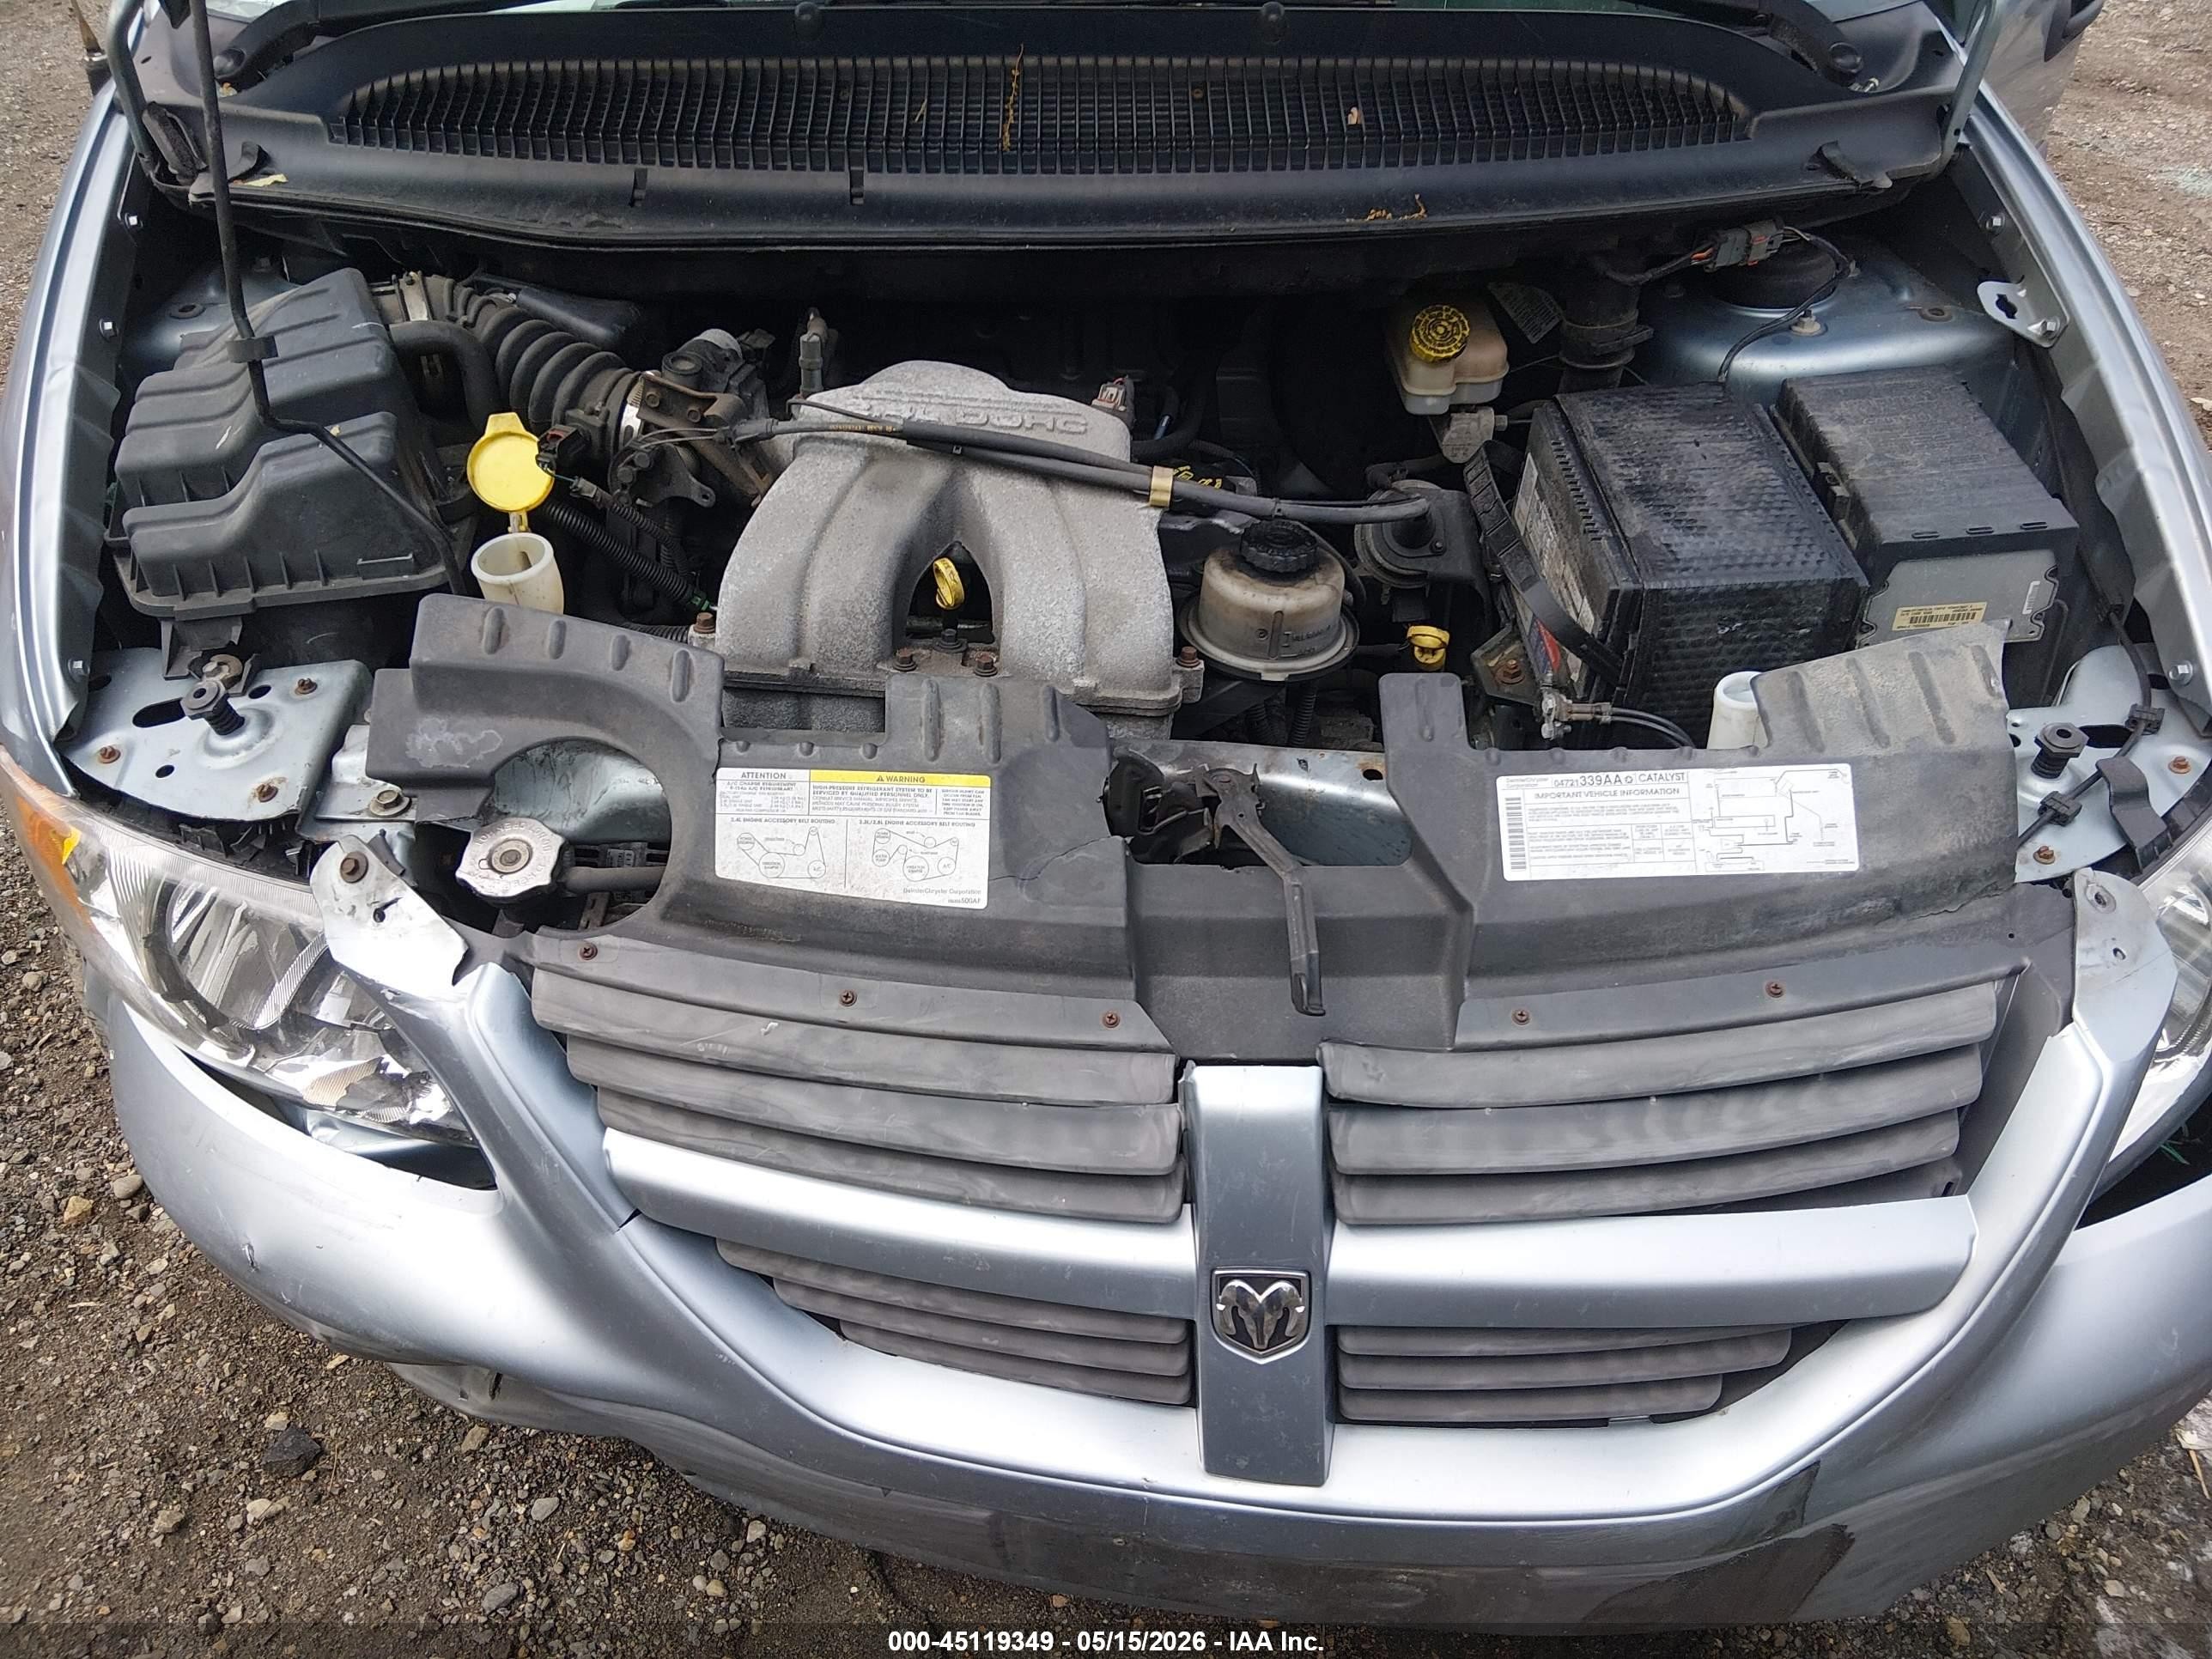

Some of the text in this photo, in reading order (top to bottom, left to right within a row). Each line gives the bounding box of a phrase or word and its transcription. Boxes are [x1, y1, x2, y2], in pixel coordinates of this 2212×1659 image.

[741, 771, 787, 780] ATTENTION
[1638, 772, 1686, 782] CATALYST
[1534, 787, 1680, 799] IMPORTANT VEHICLE INFORMATION
